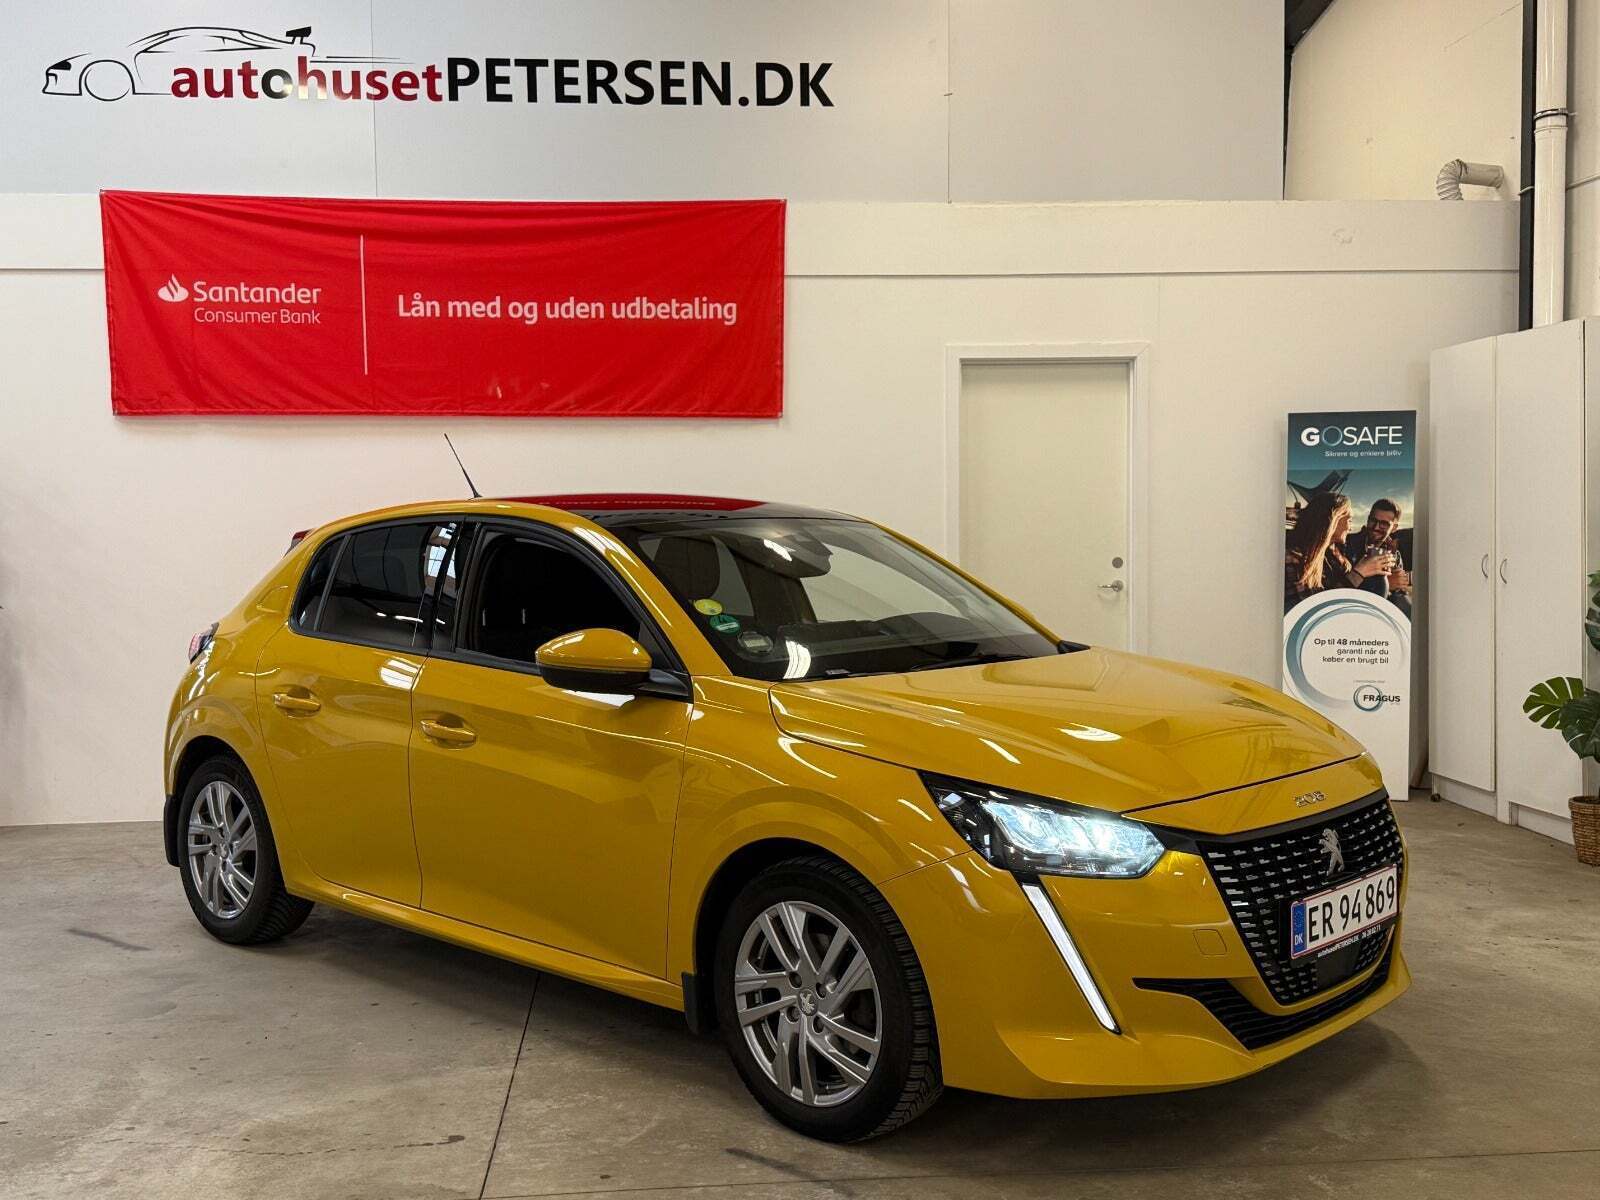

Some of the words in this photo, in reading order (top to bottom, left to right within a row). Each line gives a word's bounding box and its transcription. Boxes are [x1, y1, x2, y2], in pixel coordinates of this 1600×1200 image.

[171, 55, 834, 107] autohusetPETERSEN.DK
[193, 281, 322, 304] Santander
[194, 307, 277, 323] Consumer
[280, 309, 321, 324] Bank
[398, 293, 440, 317] Lån
[448, 296, 501, 318] med
[508, 301, 538, 325] og
[546, 297, 604, 319] uden
[611, 297, 737, 326] udbetaling
[1300, 425, 1403, 447] GOSAFE
[1314, 638, 1326, 647] Op
[1349, 638, 1389, 646] måneders
[1358, 657, 1378, 665] brugt
[1363, 694, 1401, 702] FRAGUS
[1308, 901, 1335, 943] ER
[1339, 889, 1361, 931] 94
[1365, 875, 1395, 920] 869
[1294, 933, 1304, 946] DK
